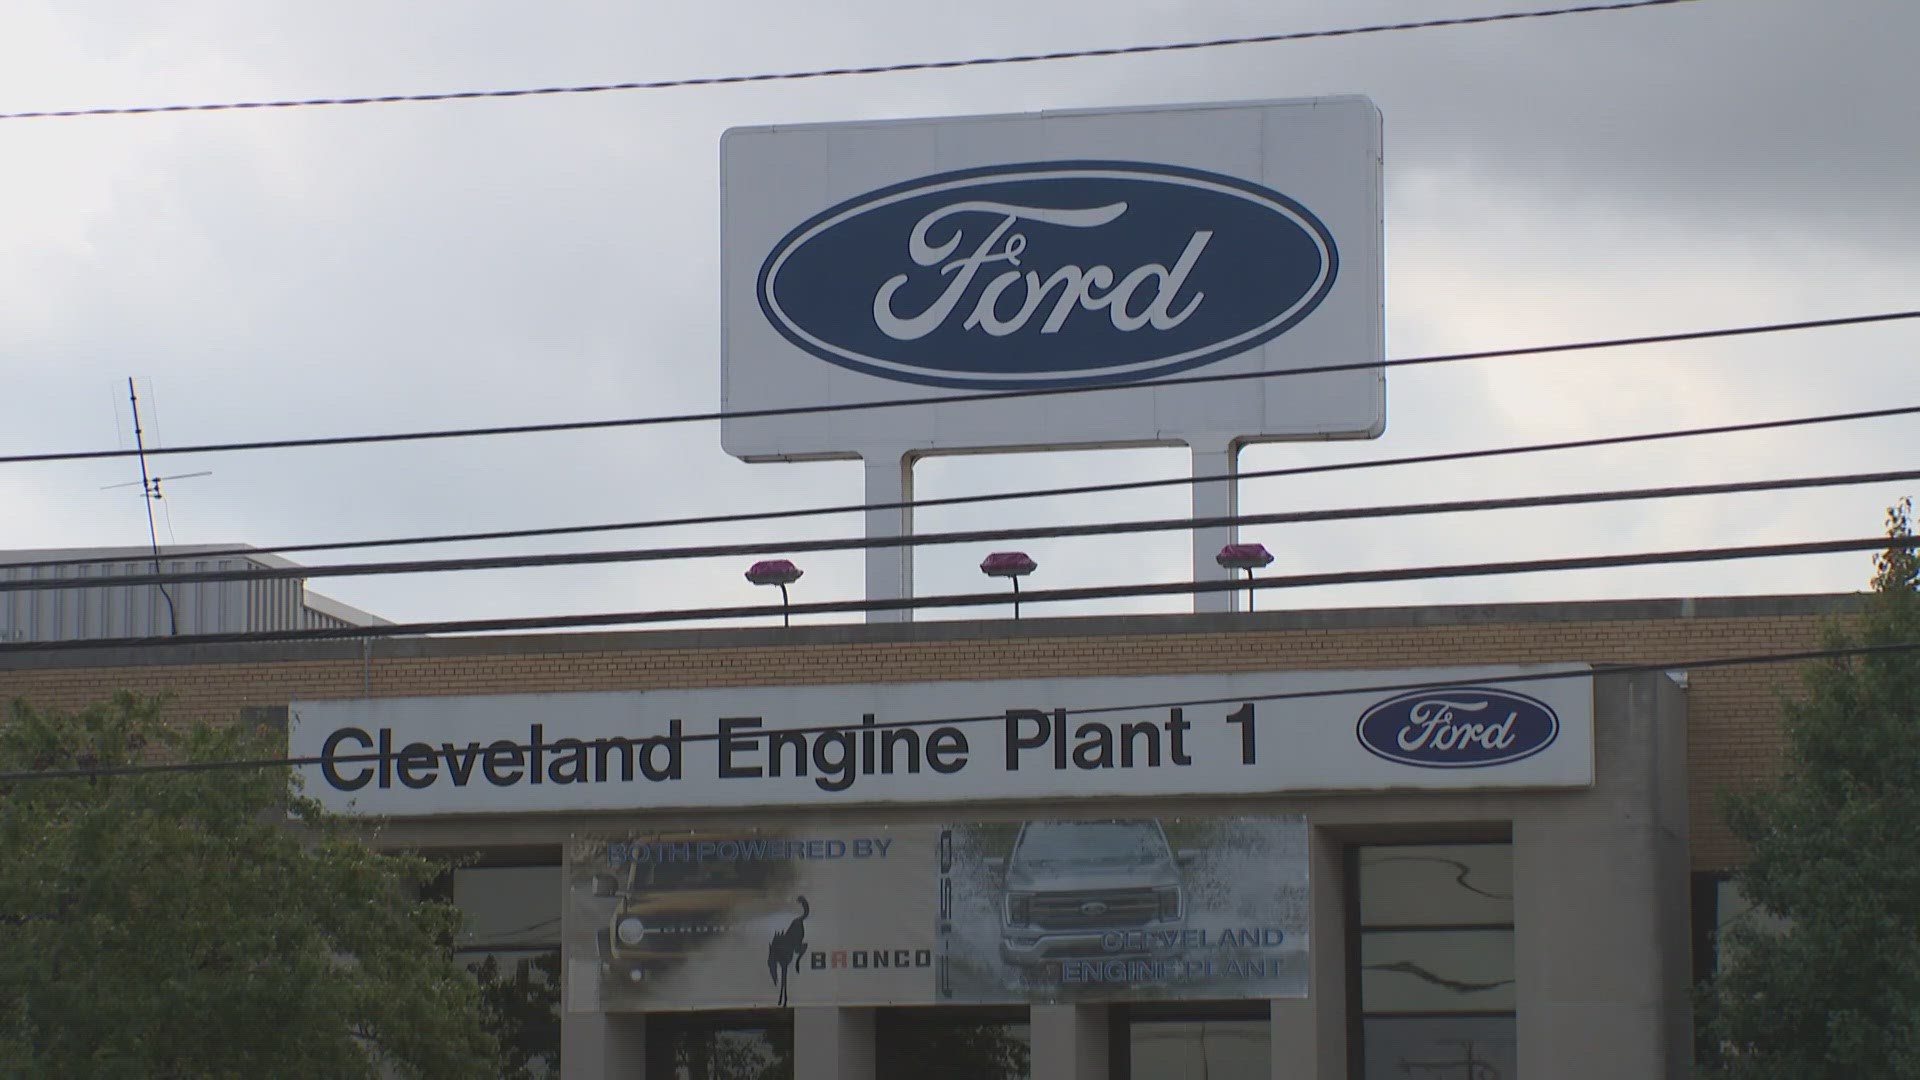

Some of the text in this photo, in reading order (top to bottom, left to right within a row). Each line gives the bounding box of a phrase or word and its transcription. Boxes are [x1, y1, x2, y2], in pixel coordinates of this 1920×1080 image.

[873, 200, 1213, 340] Ford
[1397, 700, 1517, 751] Ford
[321, 703, 1257, 791] Cleveland Engine Plant 1
[607, 837, 894, 866] BOTH POWERED BY
[811, 949, 931, 970] BRONCO
[1101, 928, 1284, 952] CLEVELAND
